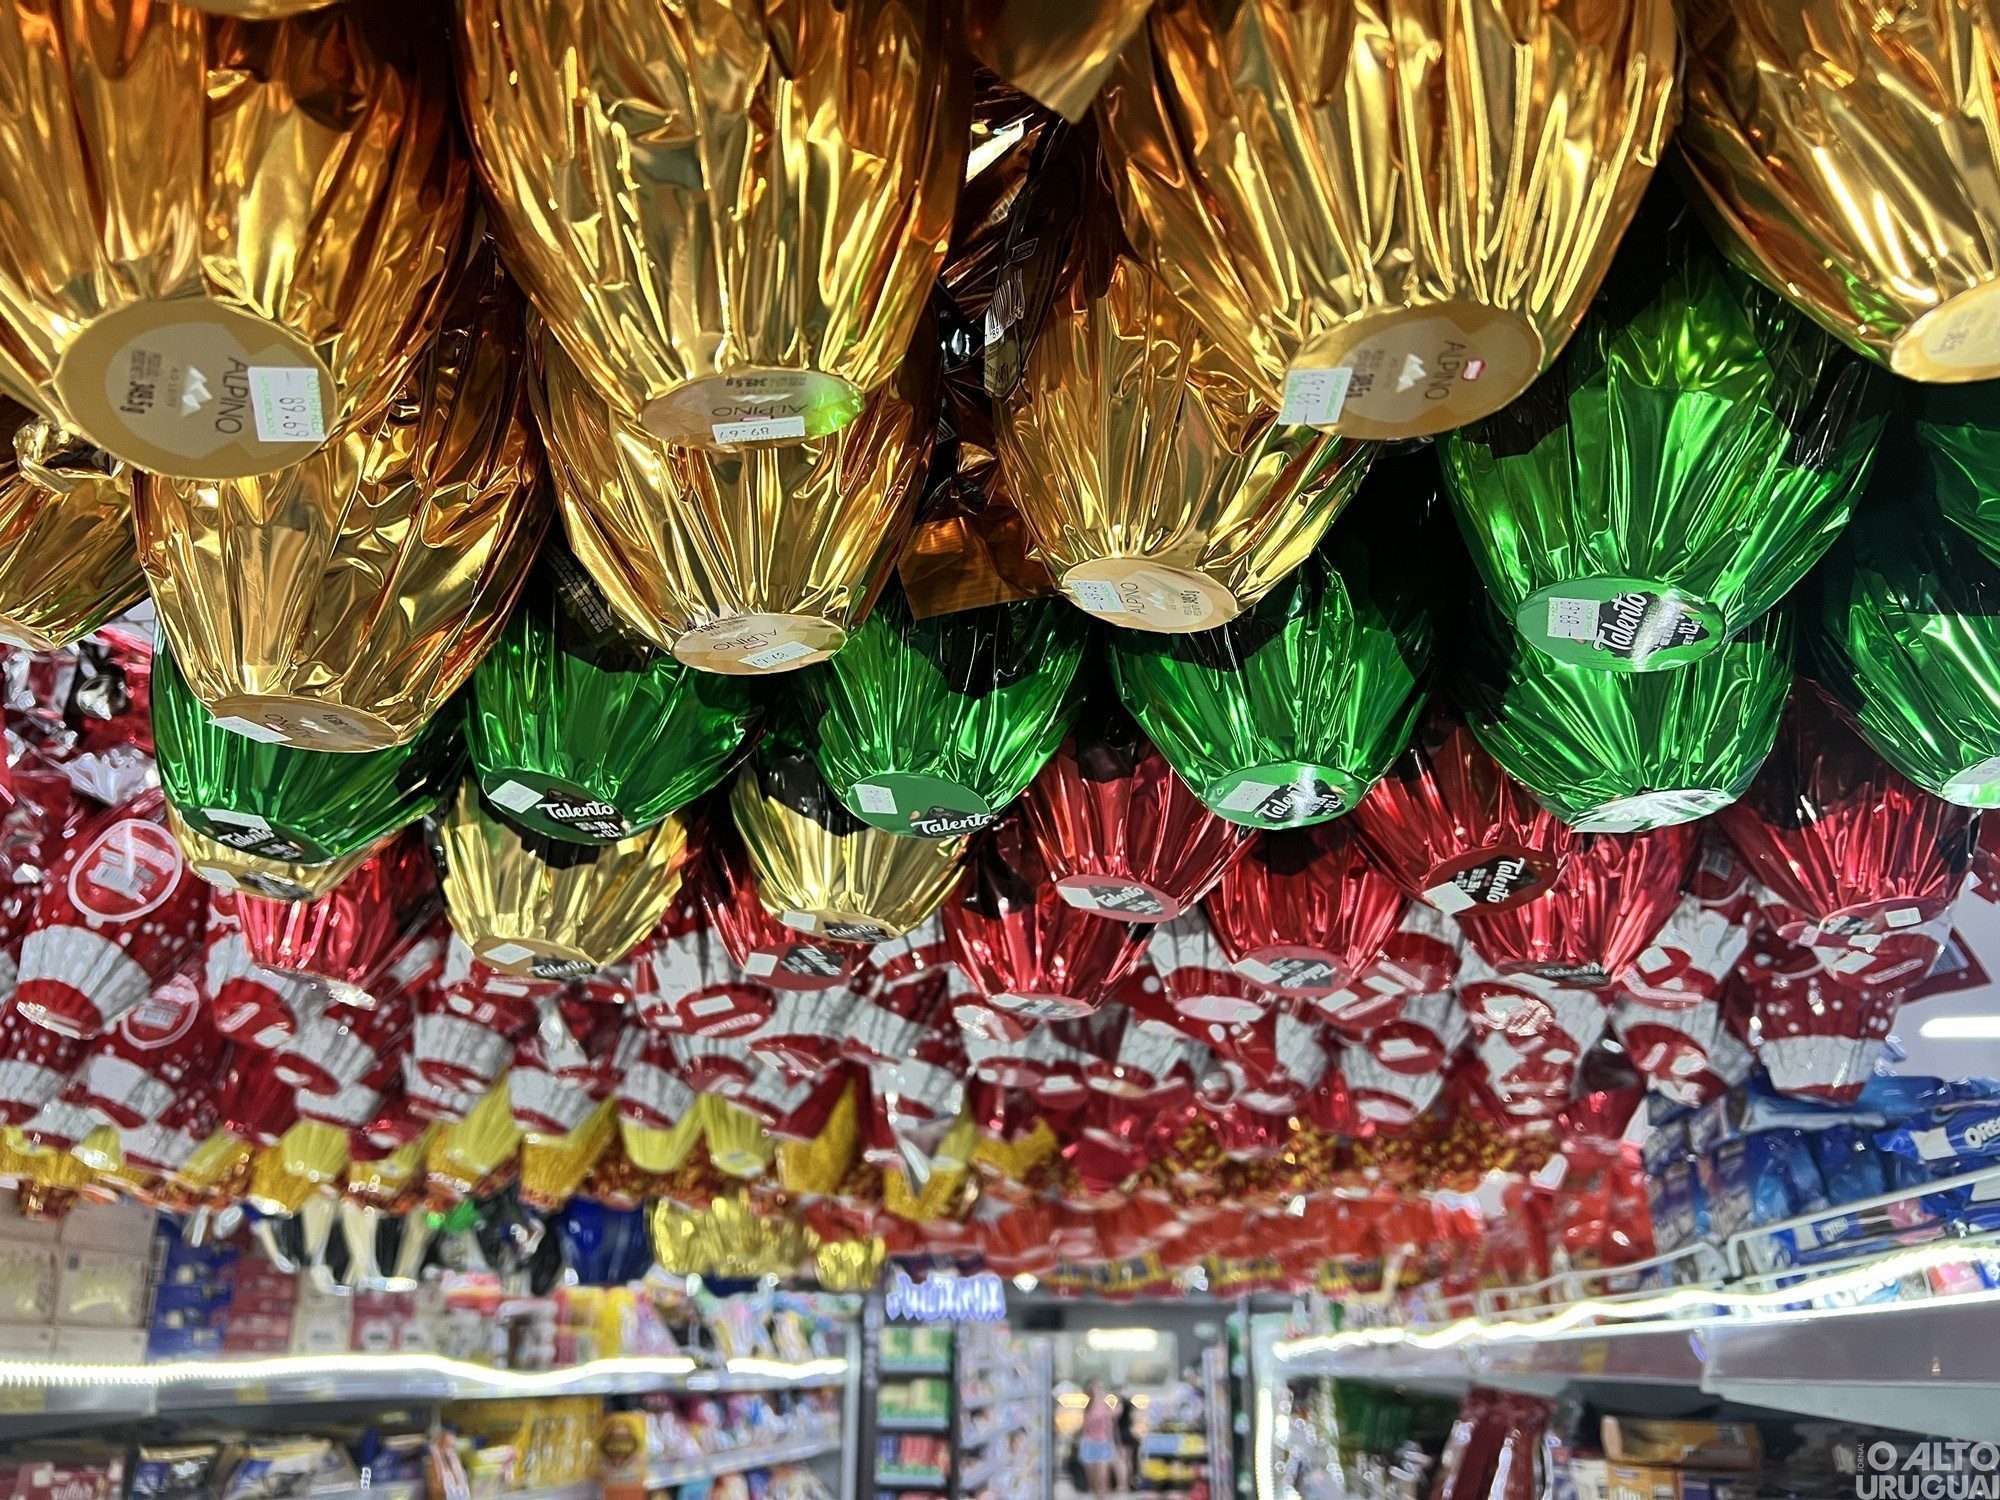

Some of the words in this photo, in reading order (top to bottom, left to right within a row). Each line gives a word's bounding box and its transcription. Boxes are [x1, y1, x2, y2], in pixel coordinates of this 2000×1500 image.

[1424, 340, 1466, 401] ALPINO
[215, 356, 250, 434] ALPINO
[279, 397, 309, 437] 89.69
[712, 404, 808, 417] ALPINO
[1120, 582, 1147, 616] ALPINO
[1593, 592, 1648, 651] Talento
[713, 628, 778, 650] ALPINO
[536, 800, 614, 819] Talento
[1253, 780, 1306, 819] Talent
[217, 827, 275, 848] Talento
[910, 814, 992, 834] Talento
[1486, 857, 1525, 903] Talento
[1094, 886, 1145, 907] Talento
[527, 960, 591, 976] Talento
